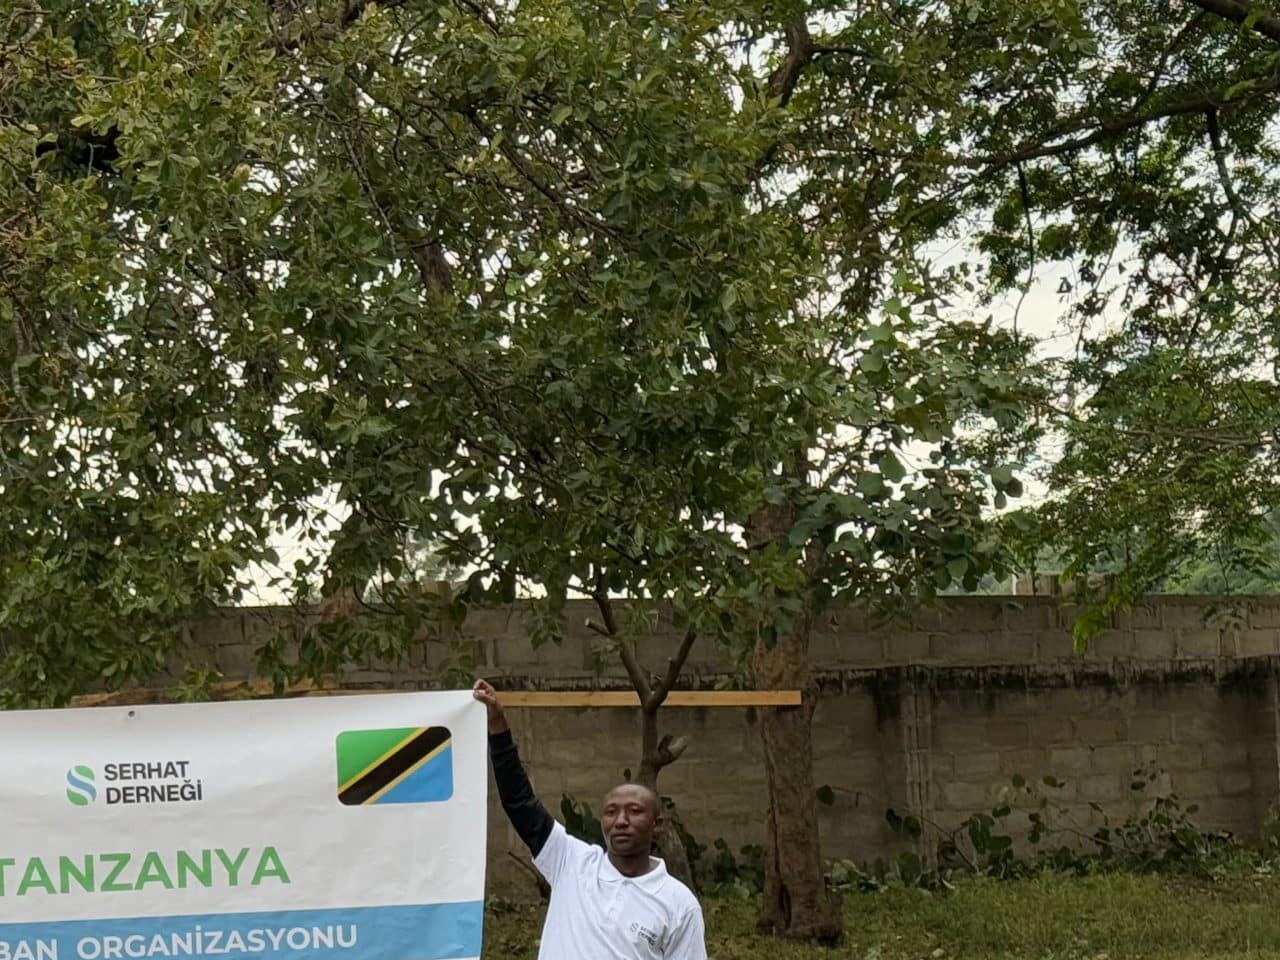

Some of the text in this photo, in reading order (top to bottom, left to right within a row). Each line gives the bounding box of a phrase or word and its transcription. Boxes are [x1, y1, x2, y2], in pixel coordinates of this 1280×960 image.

[104, 761, 190, 781] SERHAT
[106, 779, 202, 804] DERNEĞİ
[77, 923, 358, 960] ORGANİZASYONU
